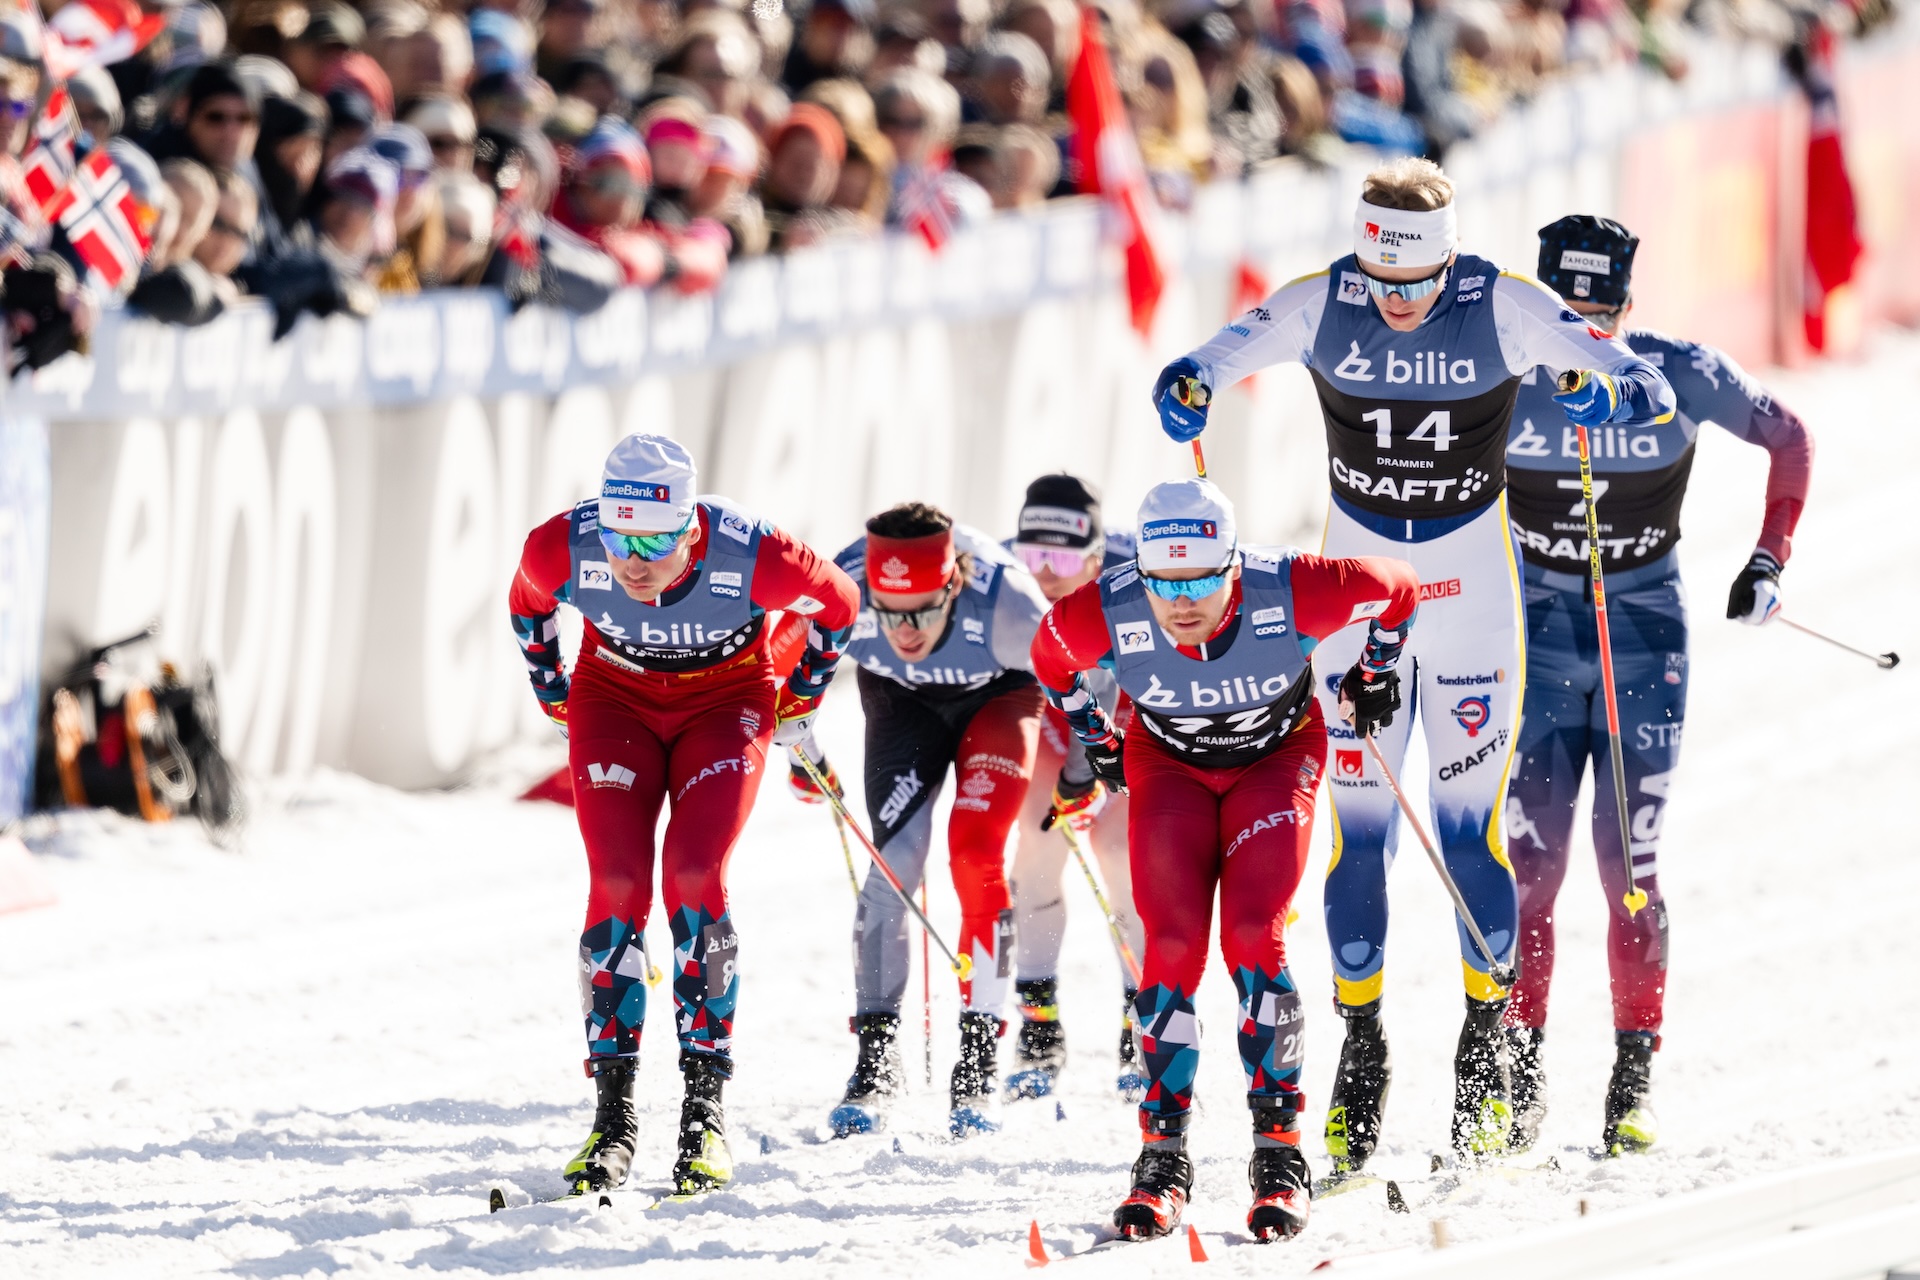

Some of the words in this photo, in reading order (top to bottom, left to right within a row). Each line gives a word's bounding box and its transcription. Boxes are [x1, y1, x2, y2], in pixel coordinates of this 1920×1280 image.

[1380, 237, 1402, 247] SPEL
[1381, 229, 1422, 241] SVENSKA
[1457, 290, 1482, 303] coop
[1386, 350, 1476, 385] bilia
[1362, 408, 1459, 452] 14
[1561, 426, 1660, 459] bilia
[1376, 456, 1434, 469] DRAMMEN
[1332, 456, 1457, 502] CRAFT
[604, 482, 654, 498] SpareBank
[1557, 479, 1609, 517] 7
[1143, 523, 1201, 539] SpareBank
[1552, 521, 1613, 533] DRAMEN
[711, 586, 740, 597] coop
[641, 622, 733, 645] bilia
[1255, 624, 1286, 636] coop
[1437, 674, 1493, 685] Sundström
[1190, 673, 1290, 708] bilia
[742, 708, 761, 720] NOR
[1450, 708, 1480, 717] Thermia
[1303, 754, 1320, 771] NOR
[1439, 737, 1497, 781] CRAFT
[677, 758, 740, 801] CRAFT
[1360, 780, 1379, 788] SPEL
[1226, 809, 1296, 858] CRAFT
